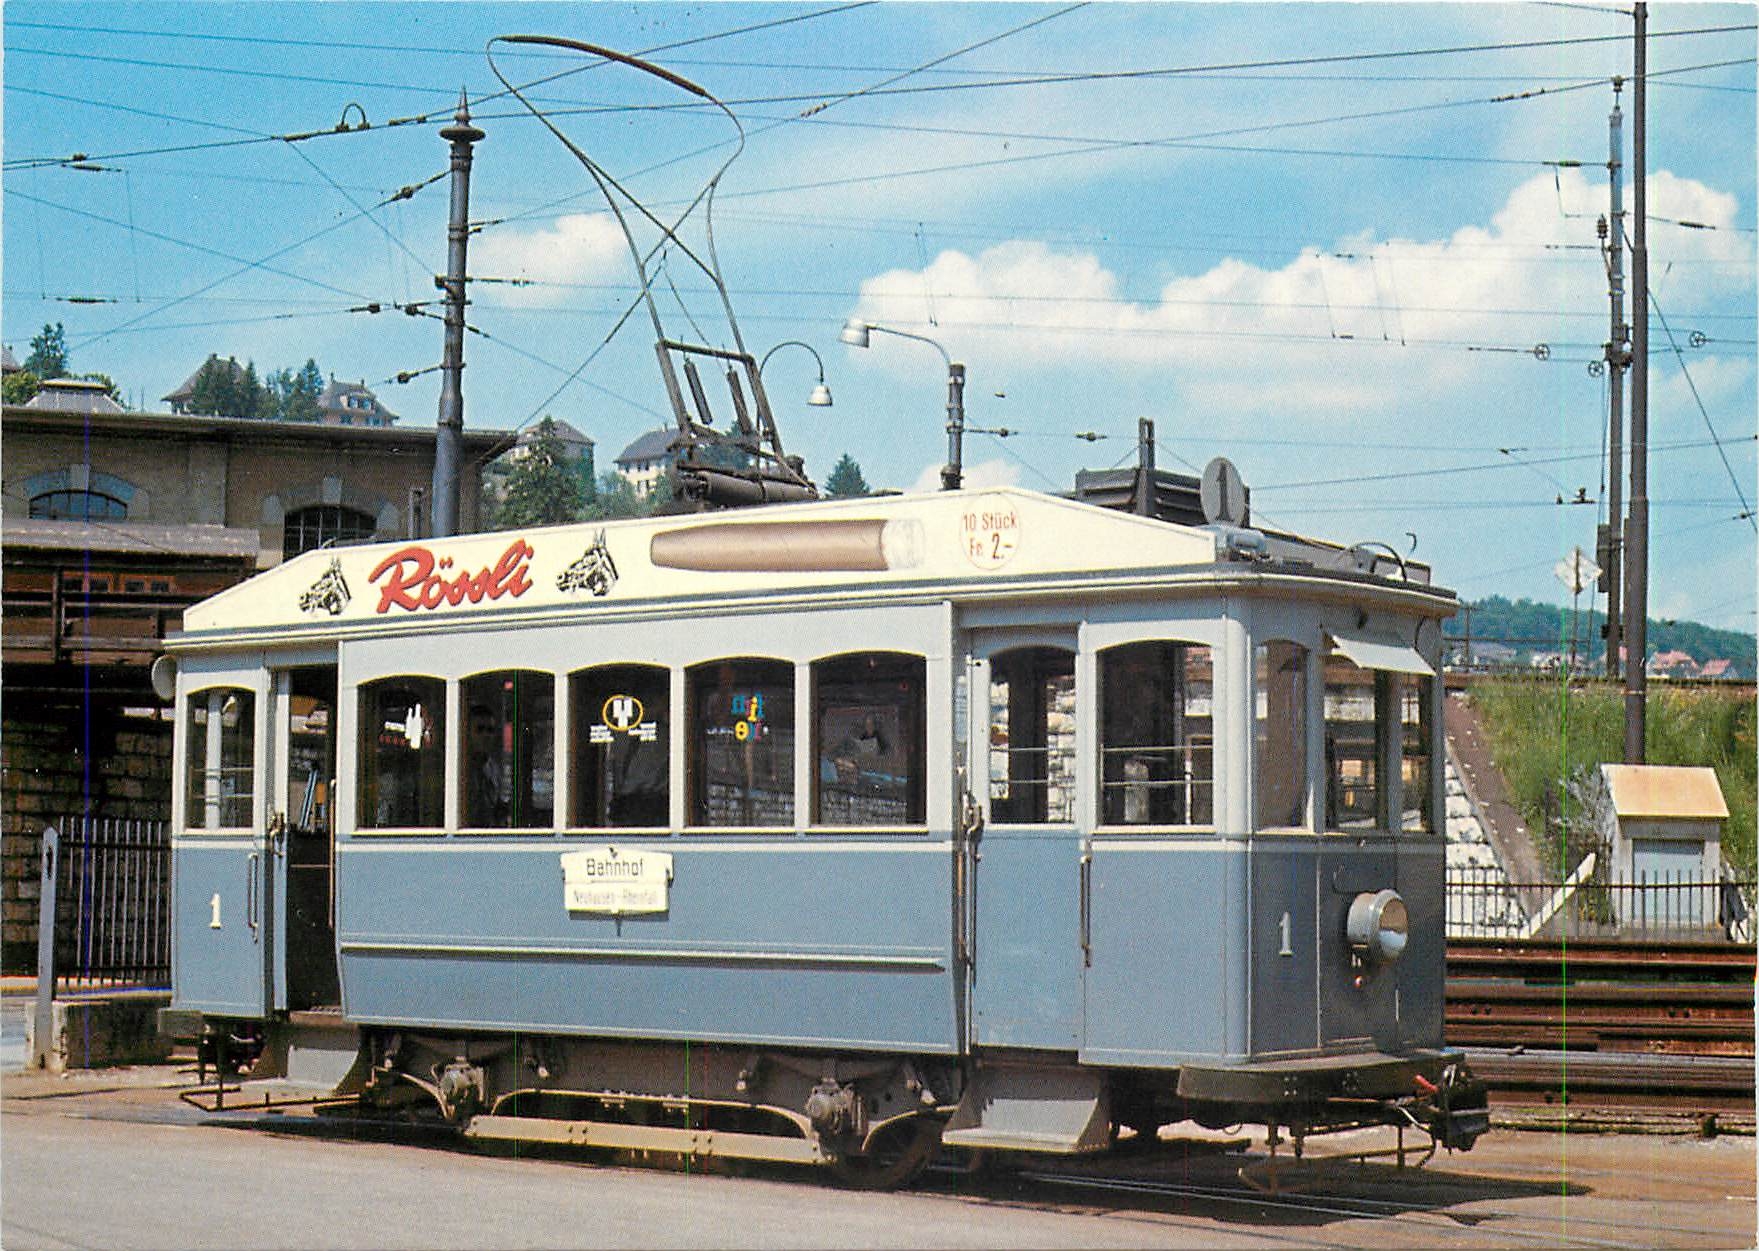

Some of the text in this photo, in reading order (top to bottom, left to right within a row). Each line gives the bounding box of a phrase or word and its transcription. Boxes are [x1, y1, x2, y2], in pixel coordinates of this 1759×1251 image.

[1215, 461, 1231, 522] 1
[963, 511, 1017, 531] 10 Stück
[368, 538, 534, 614] Rössli
[586, 858, 644, 876] Bahnhof
[209, 893, 221, 928] 1
[1279, 911, 1294, 956] 1
